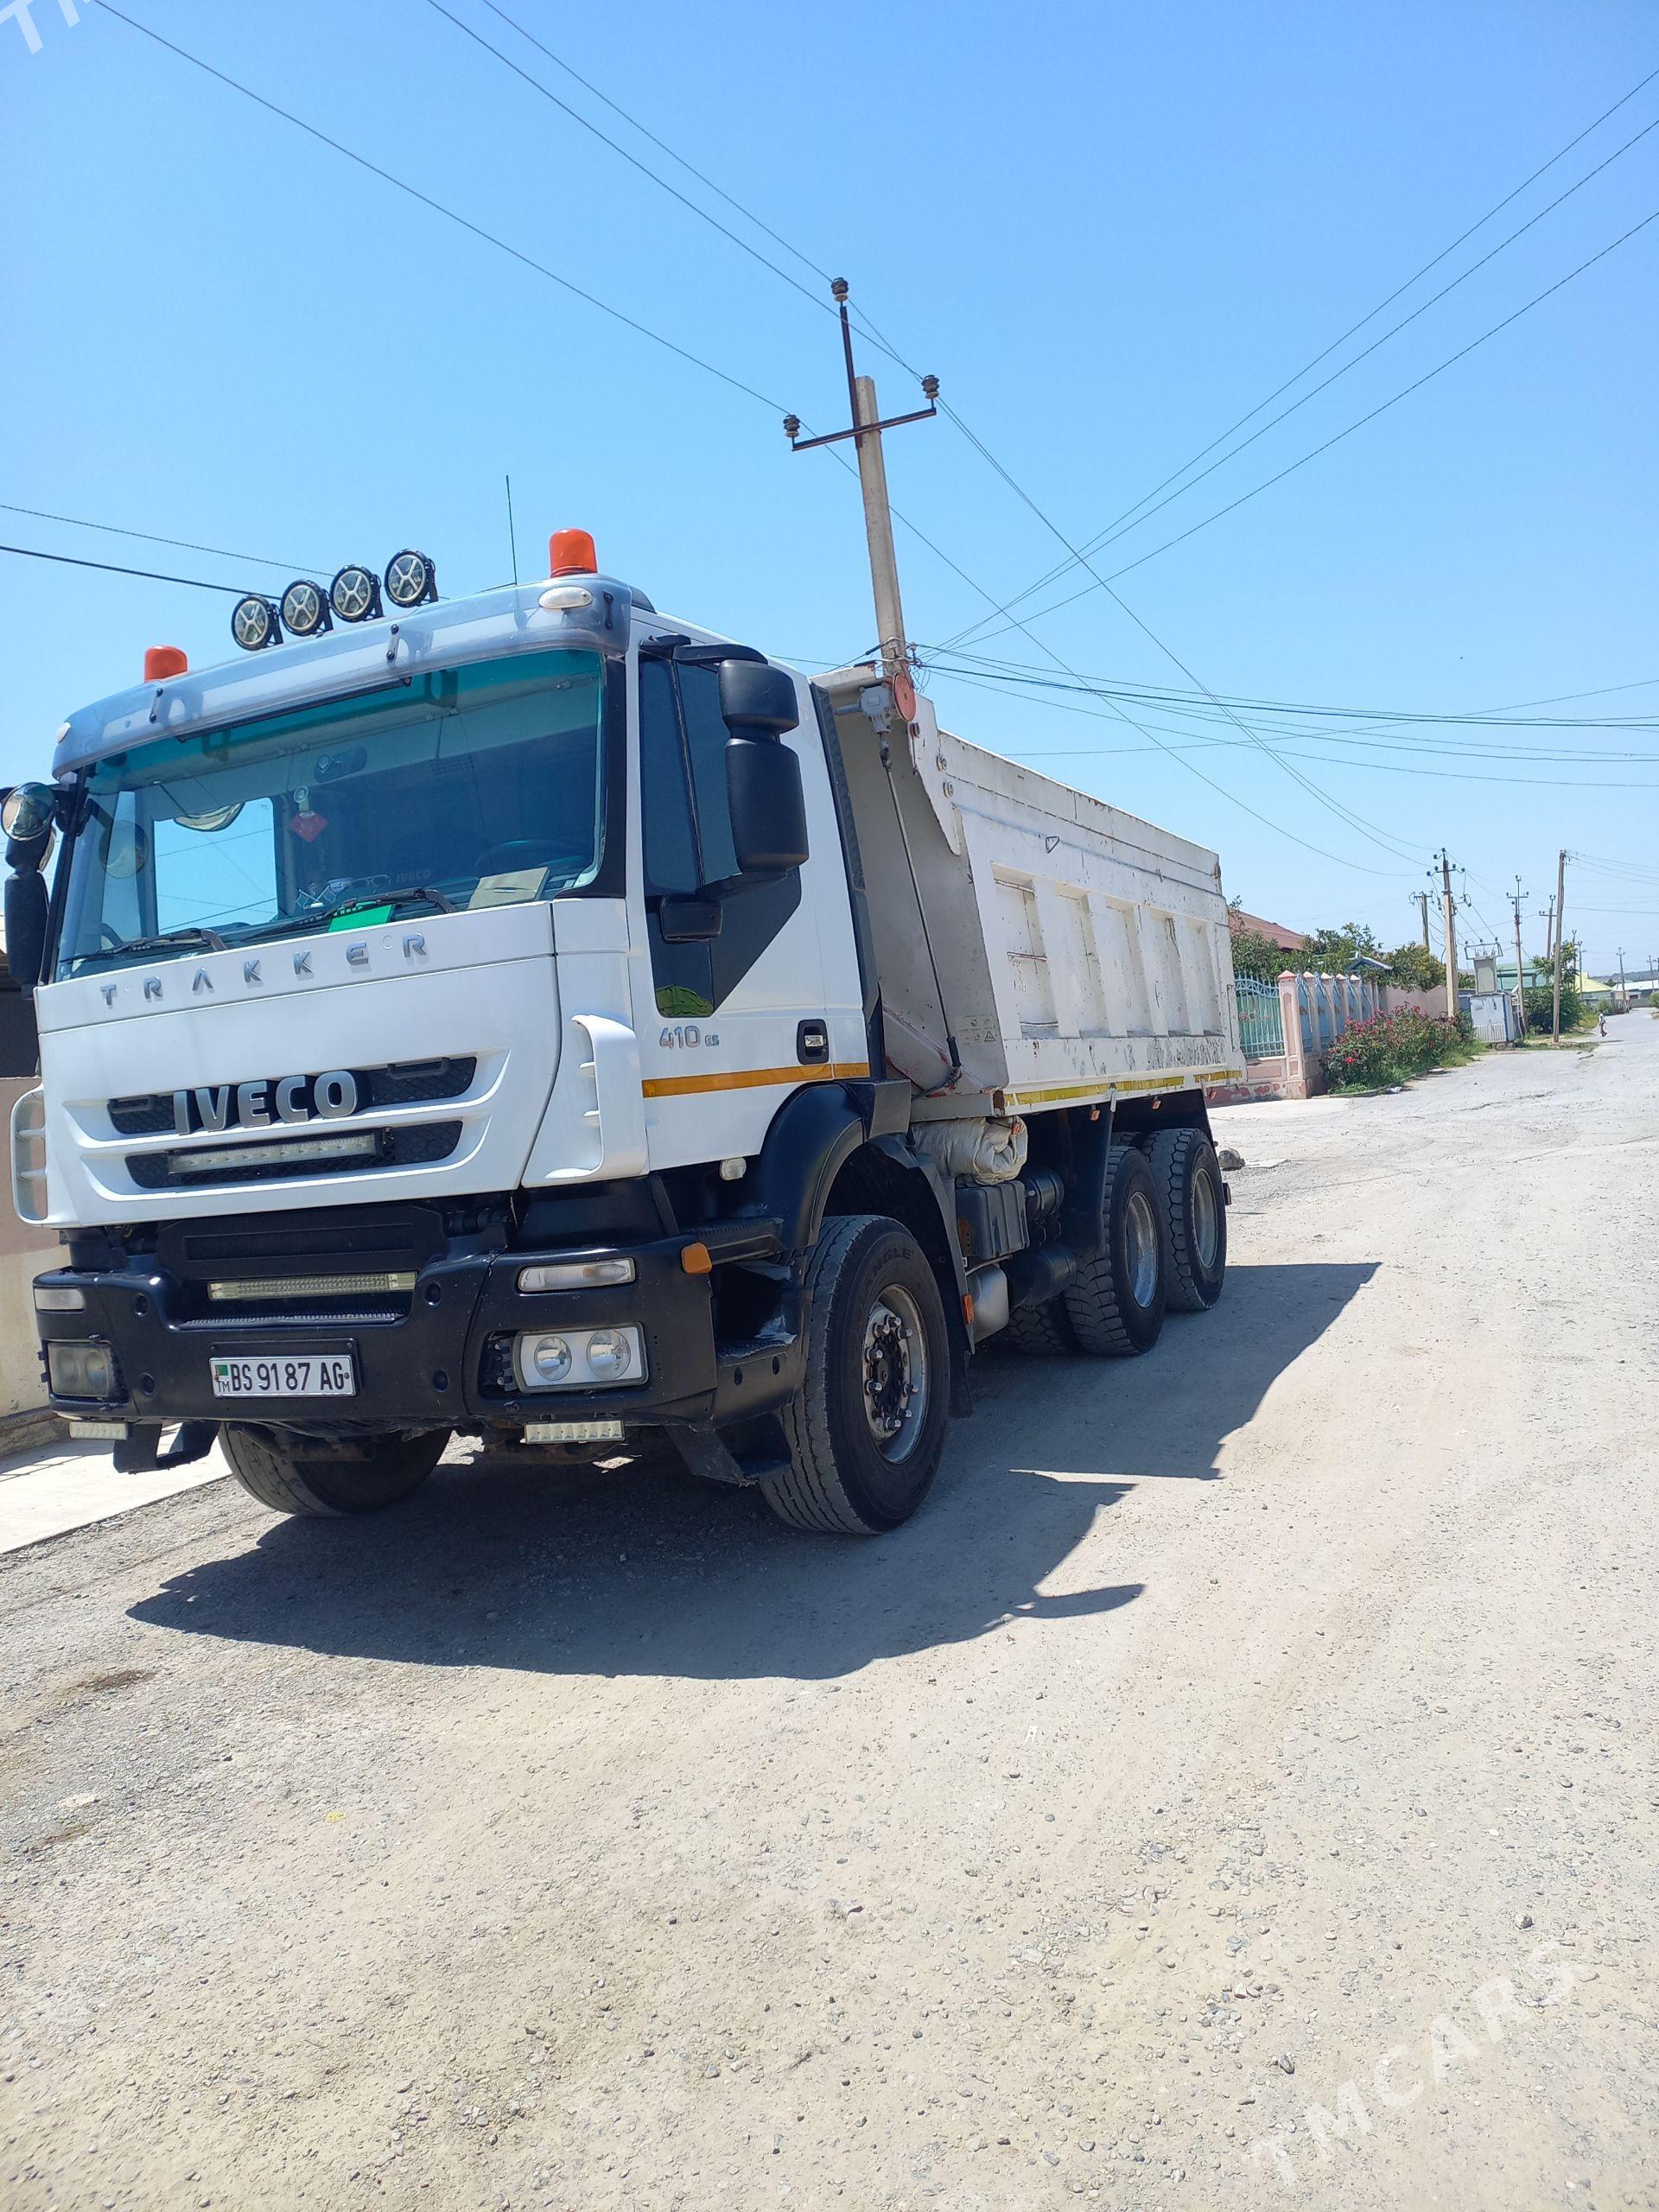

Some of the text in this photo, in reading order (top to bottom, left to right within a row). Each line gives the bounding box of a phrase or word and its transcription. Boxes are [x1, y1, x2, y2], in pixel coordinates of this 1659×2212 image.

[396, 868, 431, 884] IVECO
[100, 931, 427, 1006] TRAKKER
[659, 1025, 701, 1049] 410
[174, 1070, 358, 1135] IVECO
[230, 1363, 253, 1392] BS
[320, 1361, 345, 1390] AG
